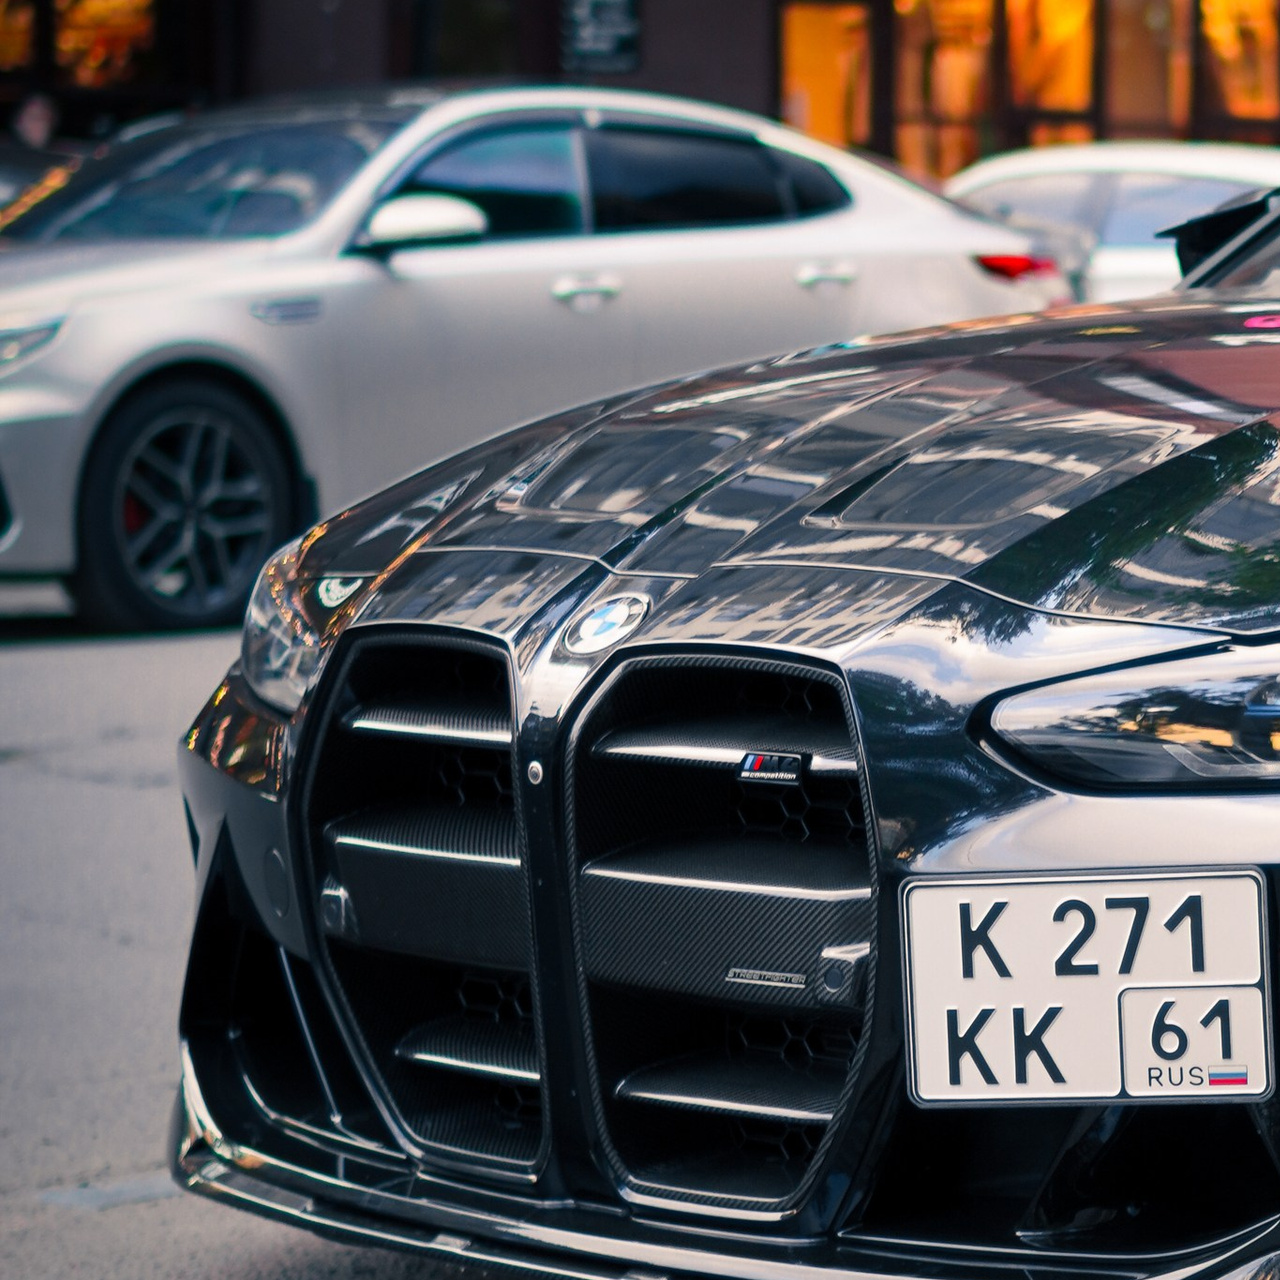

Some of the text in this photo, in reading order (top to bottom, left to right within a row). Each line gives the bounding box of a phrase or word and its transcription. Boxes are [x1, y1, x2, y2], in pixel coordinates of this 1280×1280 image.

[749, 771, 797, 780] competition
[958, 894, 1206, 979] K 271
[727, 969, 807, 984] STREETFIGHTER
[945, 1006, 1067, 1086] KK
[1151, 999, 1232, 1061] 61
[1147, 1066, 1204, 1087] RUS
